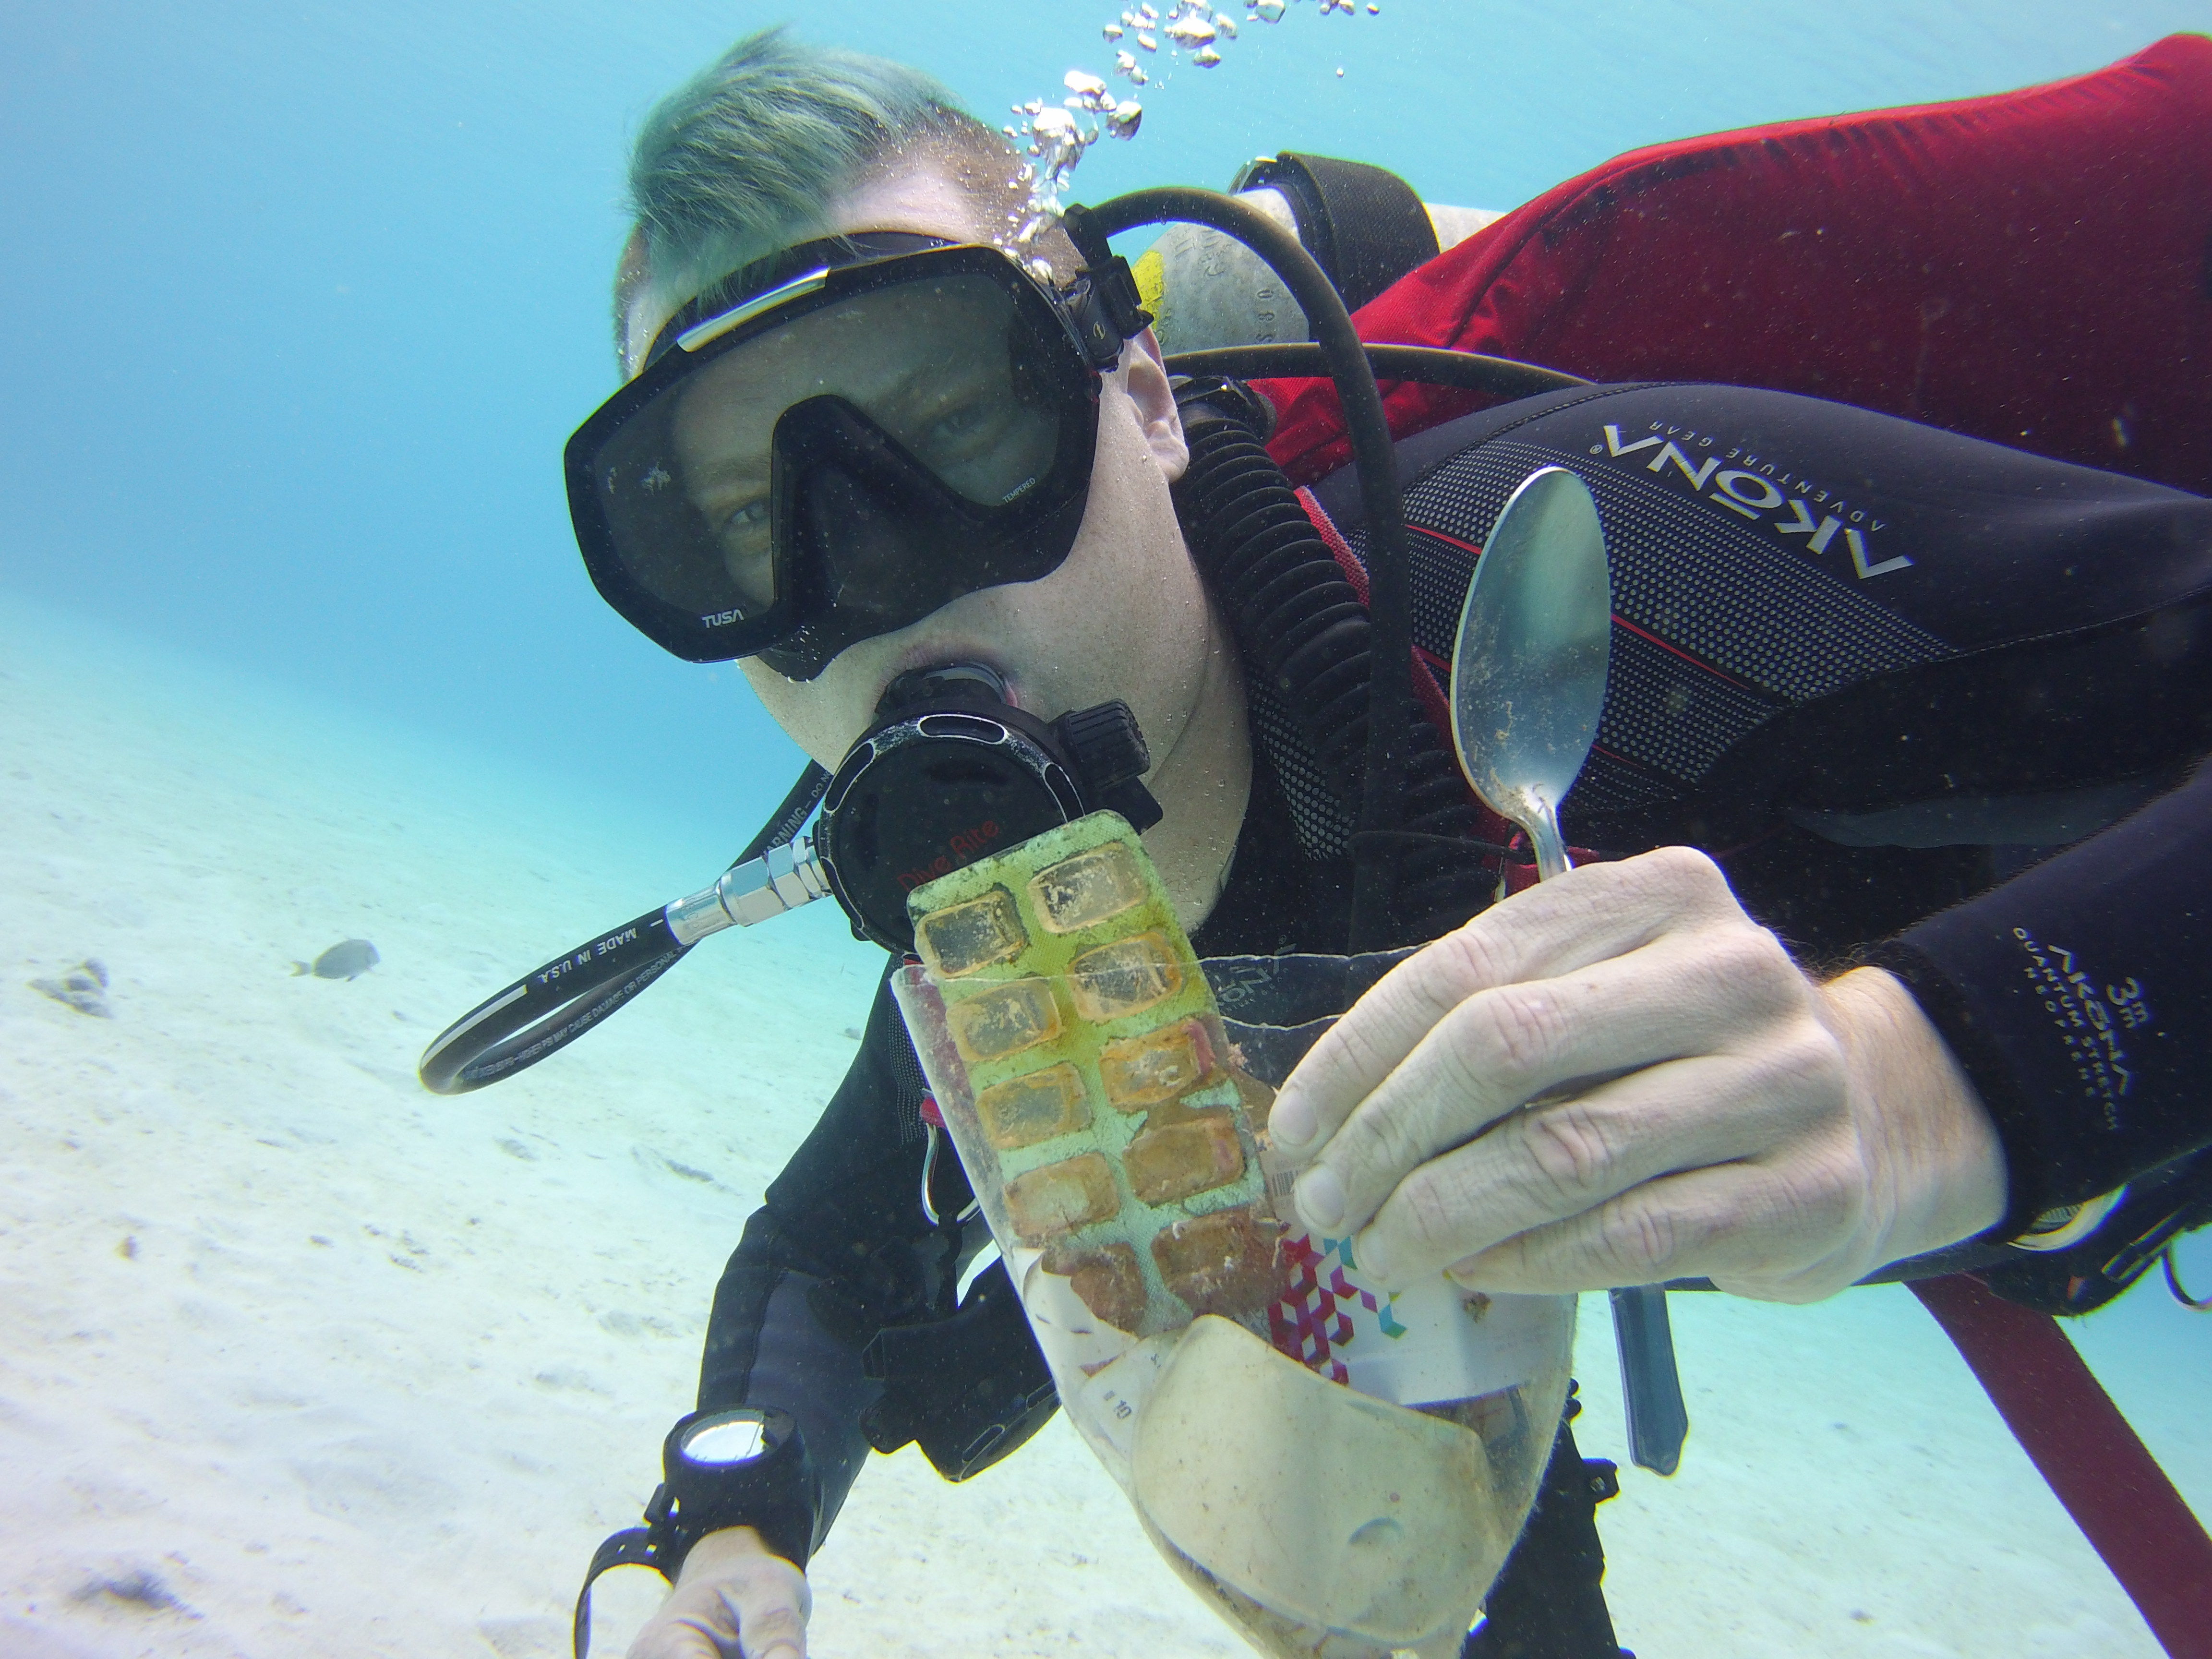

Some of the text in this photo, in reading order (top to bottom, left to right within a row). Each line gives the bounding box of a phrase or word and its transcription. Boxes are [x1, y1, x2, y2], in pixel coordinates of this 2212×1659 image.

[1649, 421, 1886, 532] ADVENTURE GEAR
[1002, 477, 1035, 504] TEMPERED
[701, 609, 745, 628] TUSA
[811, 782, 823, 798] DO
[950, 820, 999, 859] Rite
[597, 927, 637, 955] MADE
[577, 949, 591, 965] IN
[2013, 927, 2084, 1027] QUANTUM
